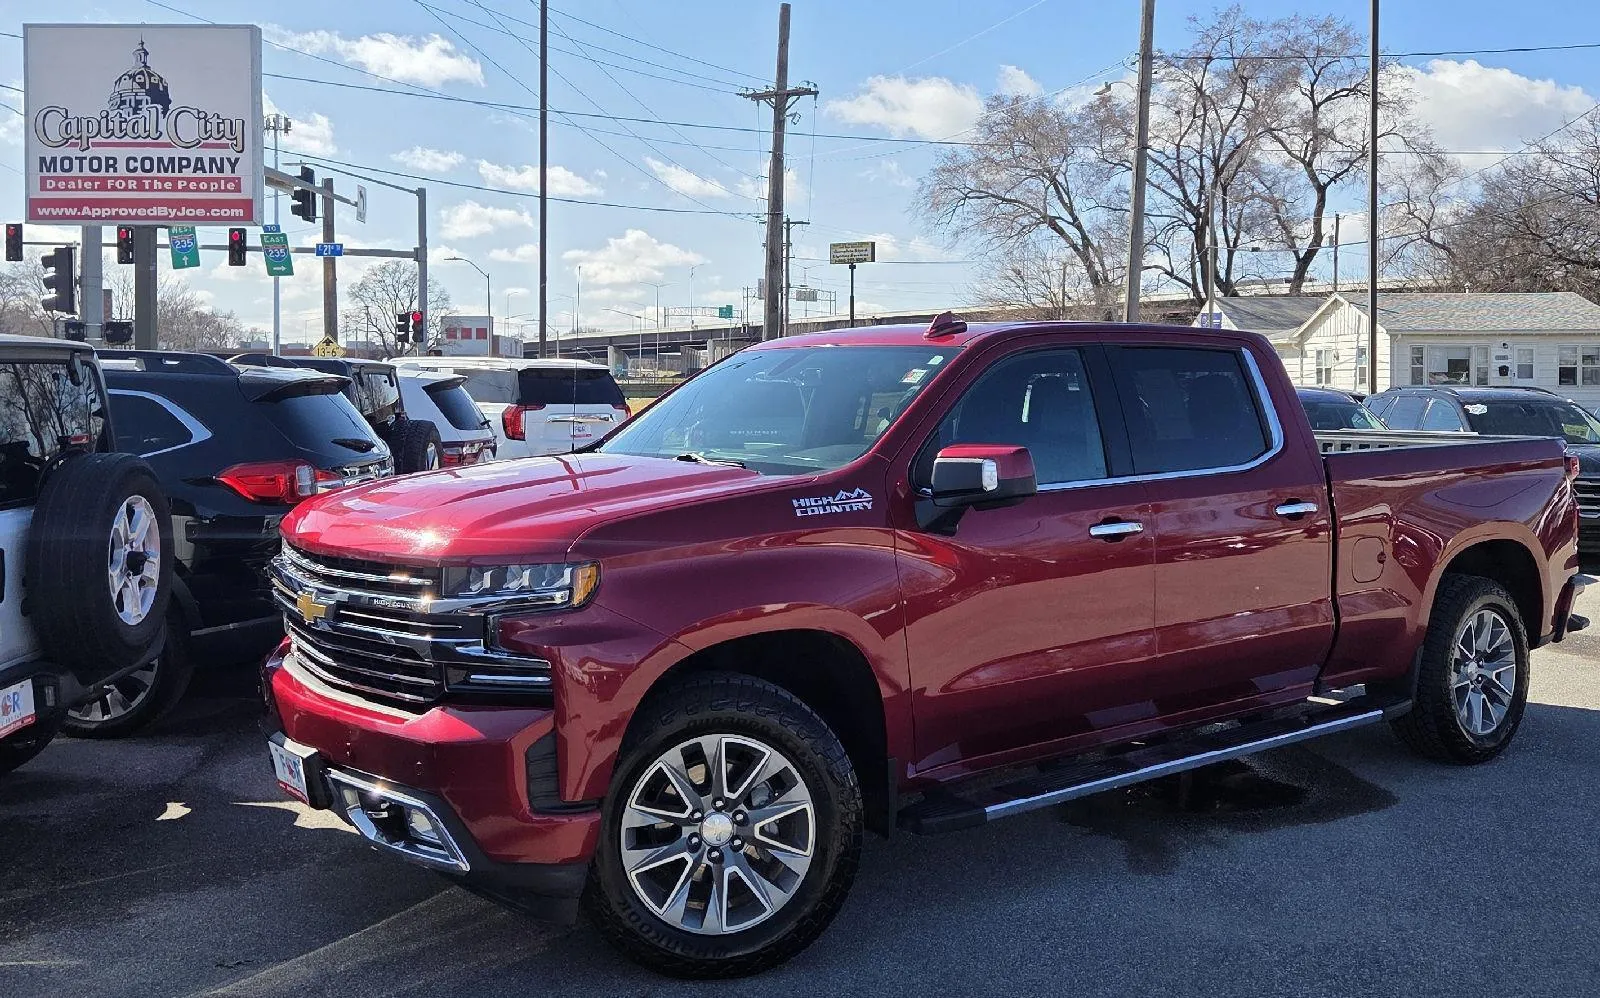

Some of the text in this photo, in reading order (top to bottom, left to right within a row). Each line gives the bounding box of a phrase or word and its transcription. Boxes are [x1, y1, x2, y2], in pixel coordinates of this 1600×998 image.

[34, 105, 245, 153] Capital City
[39, 156, 240, 174] MOTOR COMPANY
[46, 180, 236, 191] Dealer FOR The People
[37, 206, 244, 218] www.ApprovedByJoe.com
[174, 239, 193, 249] 235
[264, 235, 284, 243] EAST
[269, 249, 286, 258] 235
[792, 496, 834, 507] HIGH
[796, 501, 873, 517] COUNTRY
